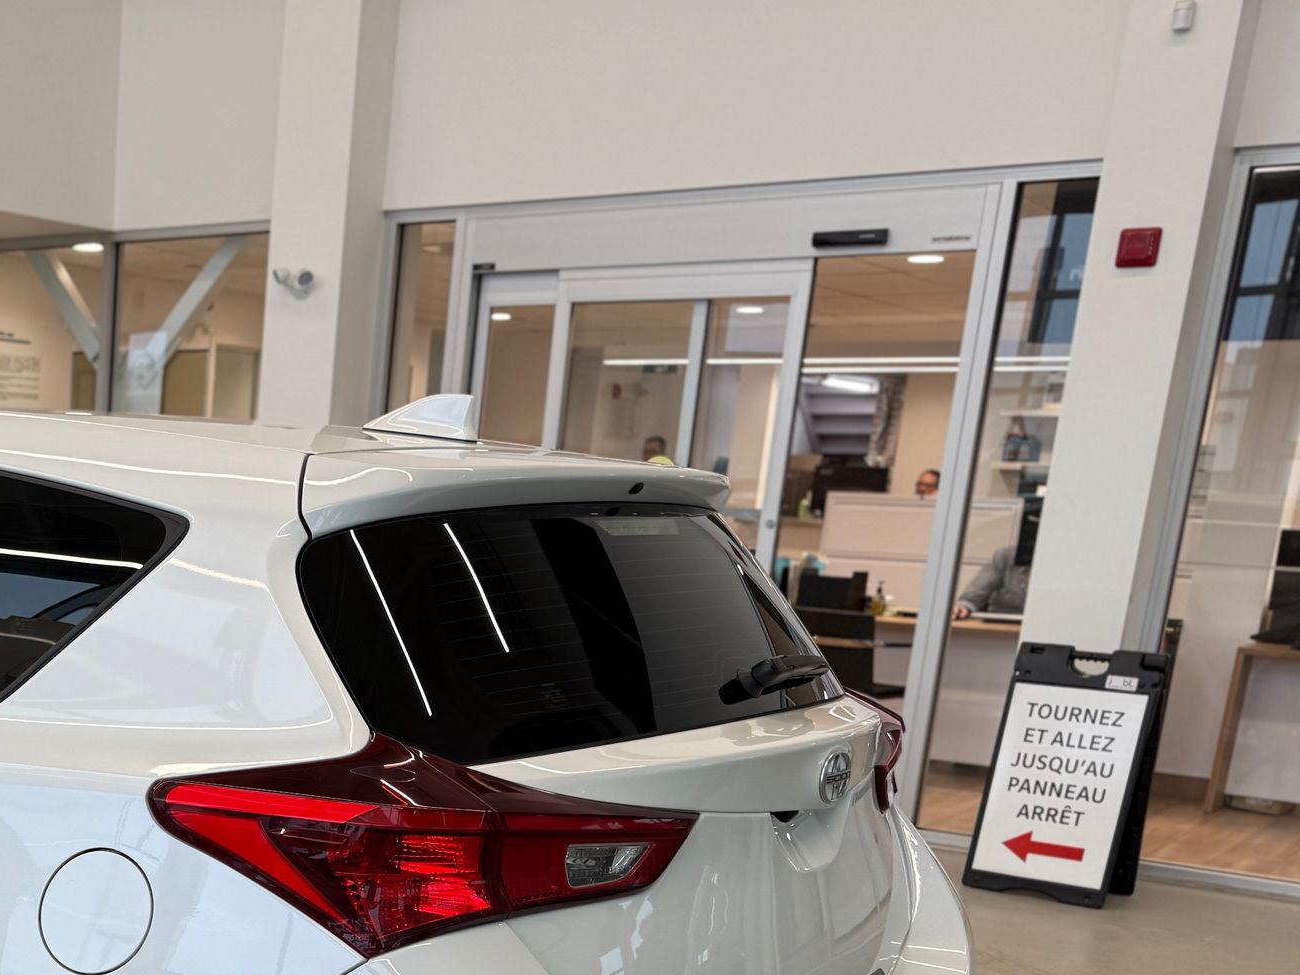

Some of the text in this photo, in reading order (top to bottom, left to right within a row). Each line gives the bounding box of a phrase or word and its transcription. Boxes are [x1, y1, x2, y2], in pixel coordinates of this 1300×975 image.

[1027, 702, 1125, 728] TOURNEZ
[1023, 728, 1115, 752] ET ALLEZ
[1010, 752, 1115, 779] JUSQU'AU
[1007, 777, 1107, 804] PANNEAU
[1016, 804, 1085, 827] ARRÊT
